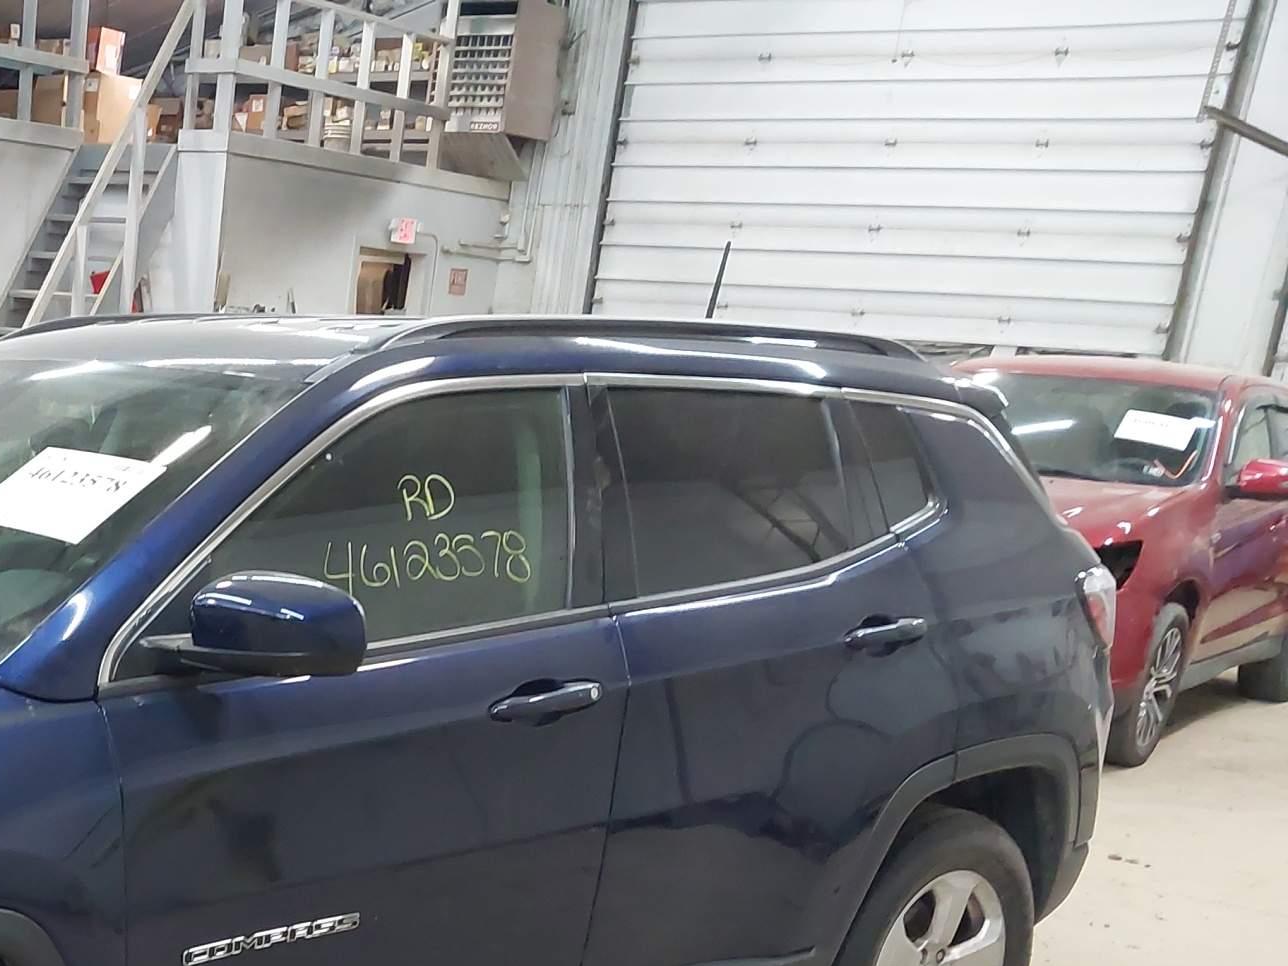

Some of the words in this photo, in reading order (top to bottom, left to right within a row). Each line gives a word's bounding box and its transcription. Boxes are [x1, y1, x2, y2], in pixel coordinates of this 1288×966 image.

[397, 474, 455, 521] RD
[324, 530, 532, 596] 46123578
[182, 912, 360, 966] COMPASS
